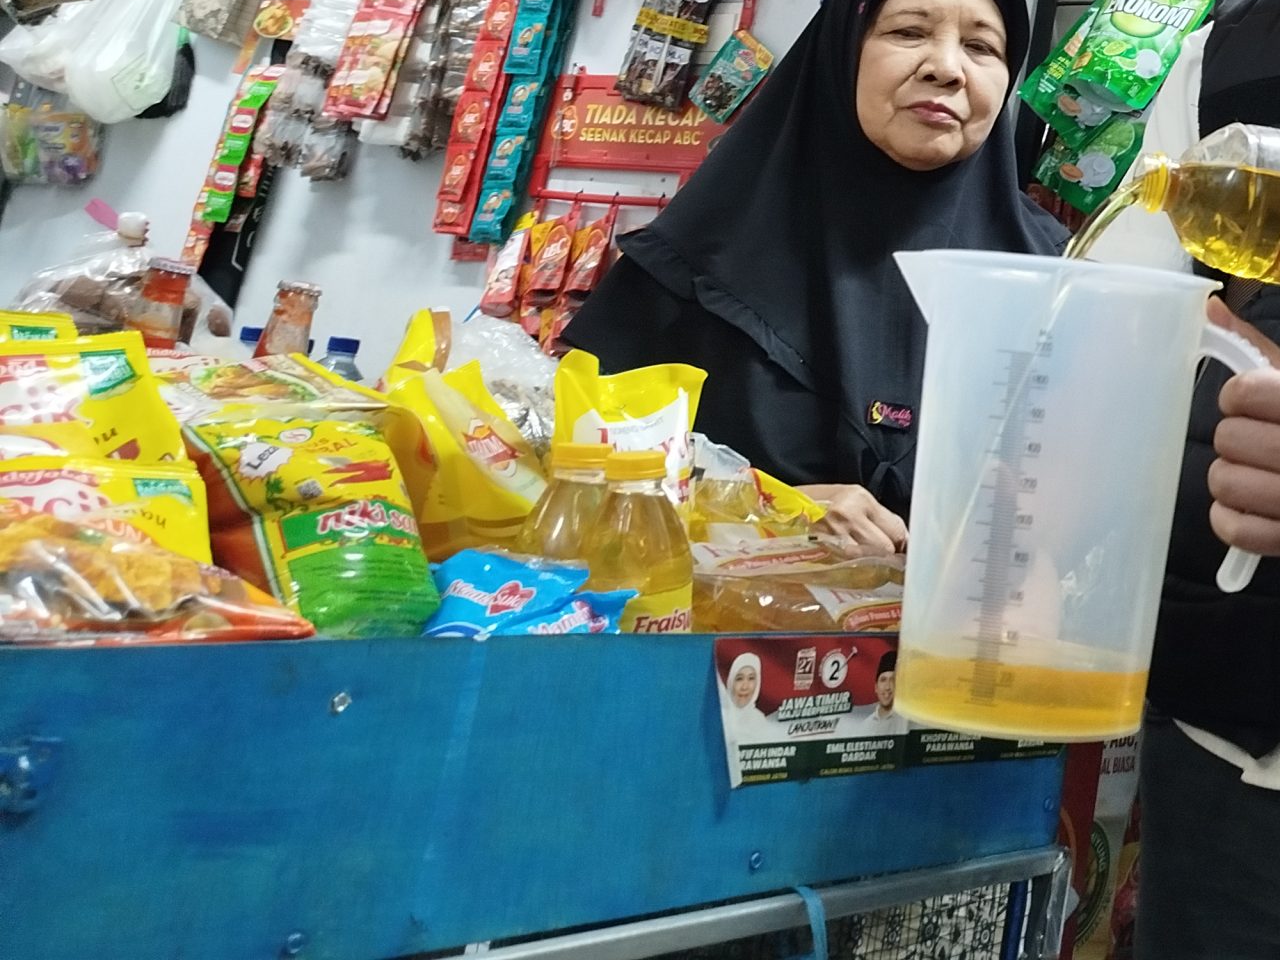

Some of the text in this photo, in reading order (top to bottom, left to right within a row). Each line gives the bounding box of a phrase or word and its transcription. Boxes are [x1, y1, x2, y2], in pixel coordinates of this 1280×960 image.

[584, 103, 708, 127] TIADA KECAP
[579, 127, 701, 146] SEENAK KECAP ABC
[798, 657, 813, 673] 27
[829, 659, 840, 681] 2
[781, 691, 850, 711] JAWA TIMUR
[826, 742, 845, 754] EMIL
[841, 751, 877, 763] DARDAK
